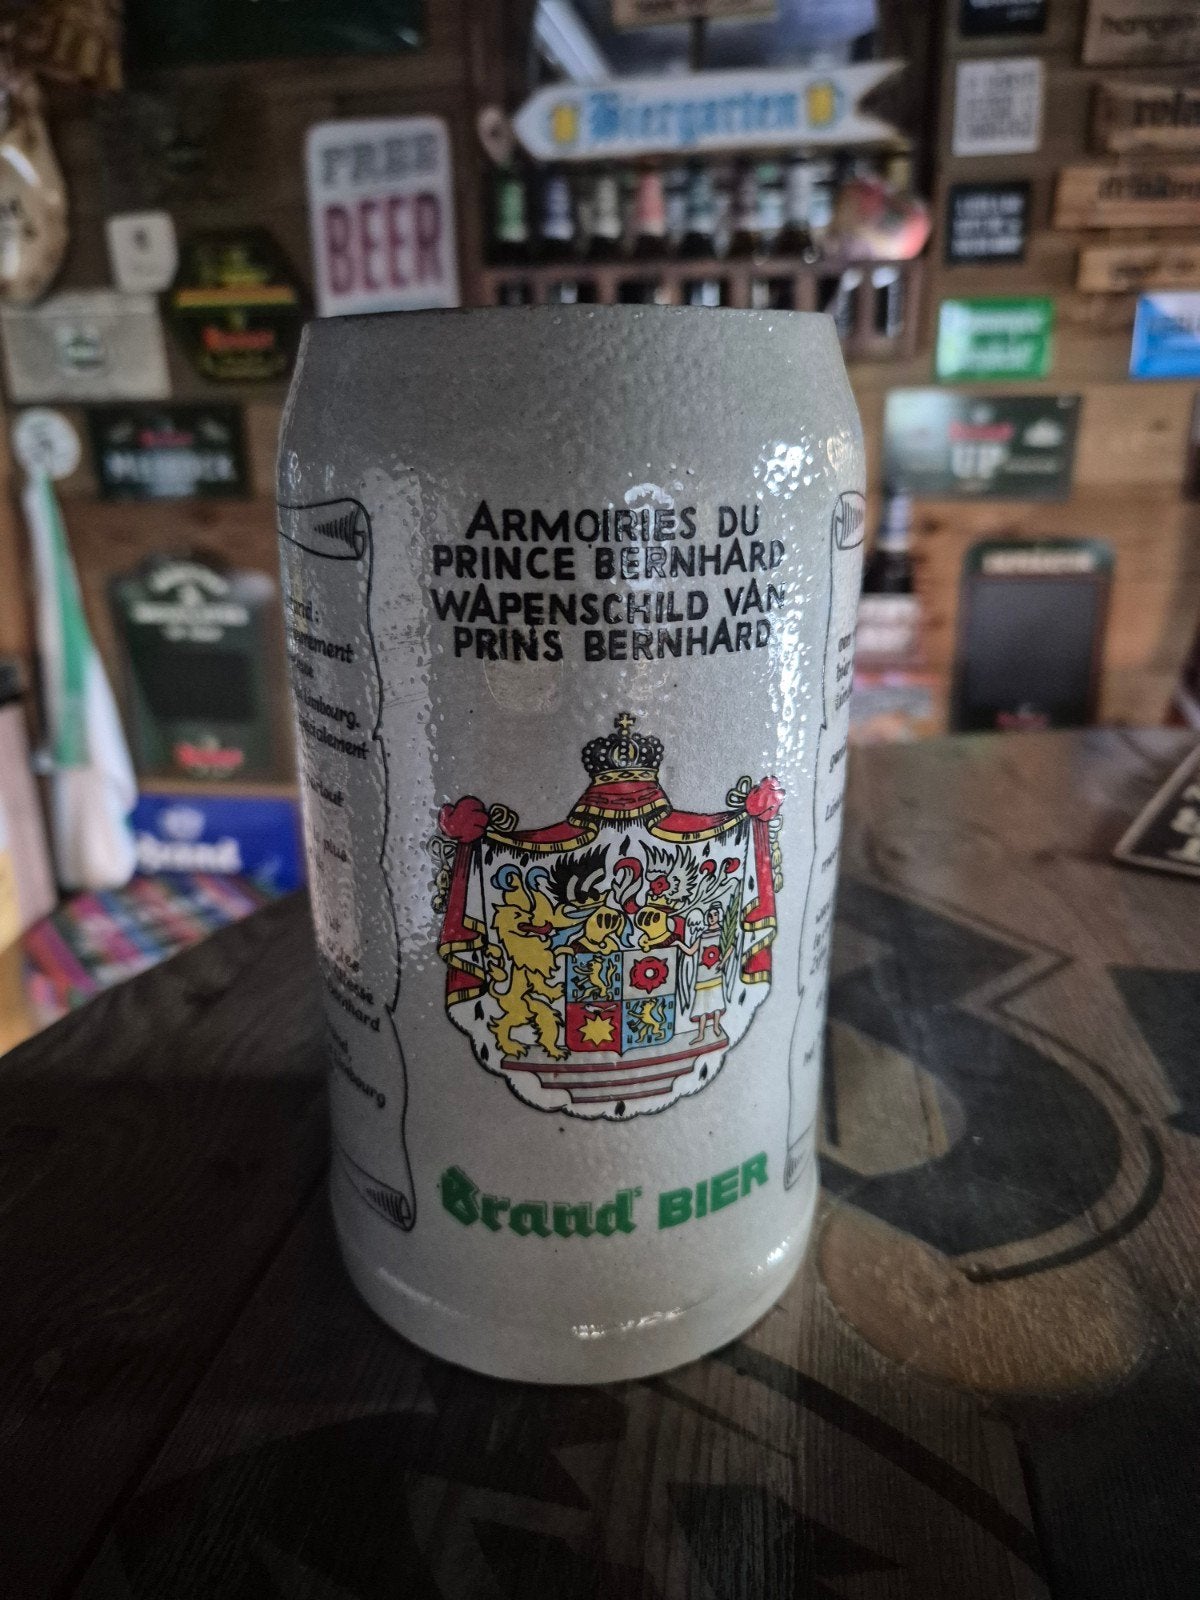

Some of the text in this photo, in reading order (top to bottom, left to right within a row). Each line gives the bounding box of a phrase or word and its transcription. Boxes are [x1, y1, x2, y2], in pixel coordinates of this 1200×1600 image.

[320, 134, 440, 187] FREE
[323, 194, 445, 296] BEER
[464, 499, 760, 543] ARMOIRIES DU
[432, 538, 787, 581] PRINCE BERNHARD
[430, 578, 786, 627] WAPENSCHILD VAN
[454, 617, 773, 662] PRINS BERNHARD
[658, 1150, 770, 1231] BIER
